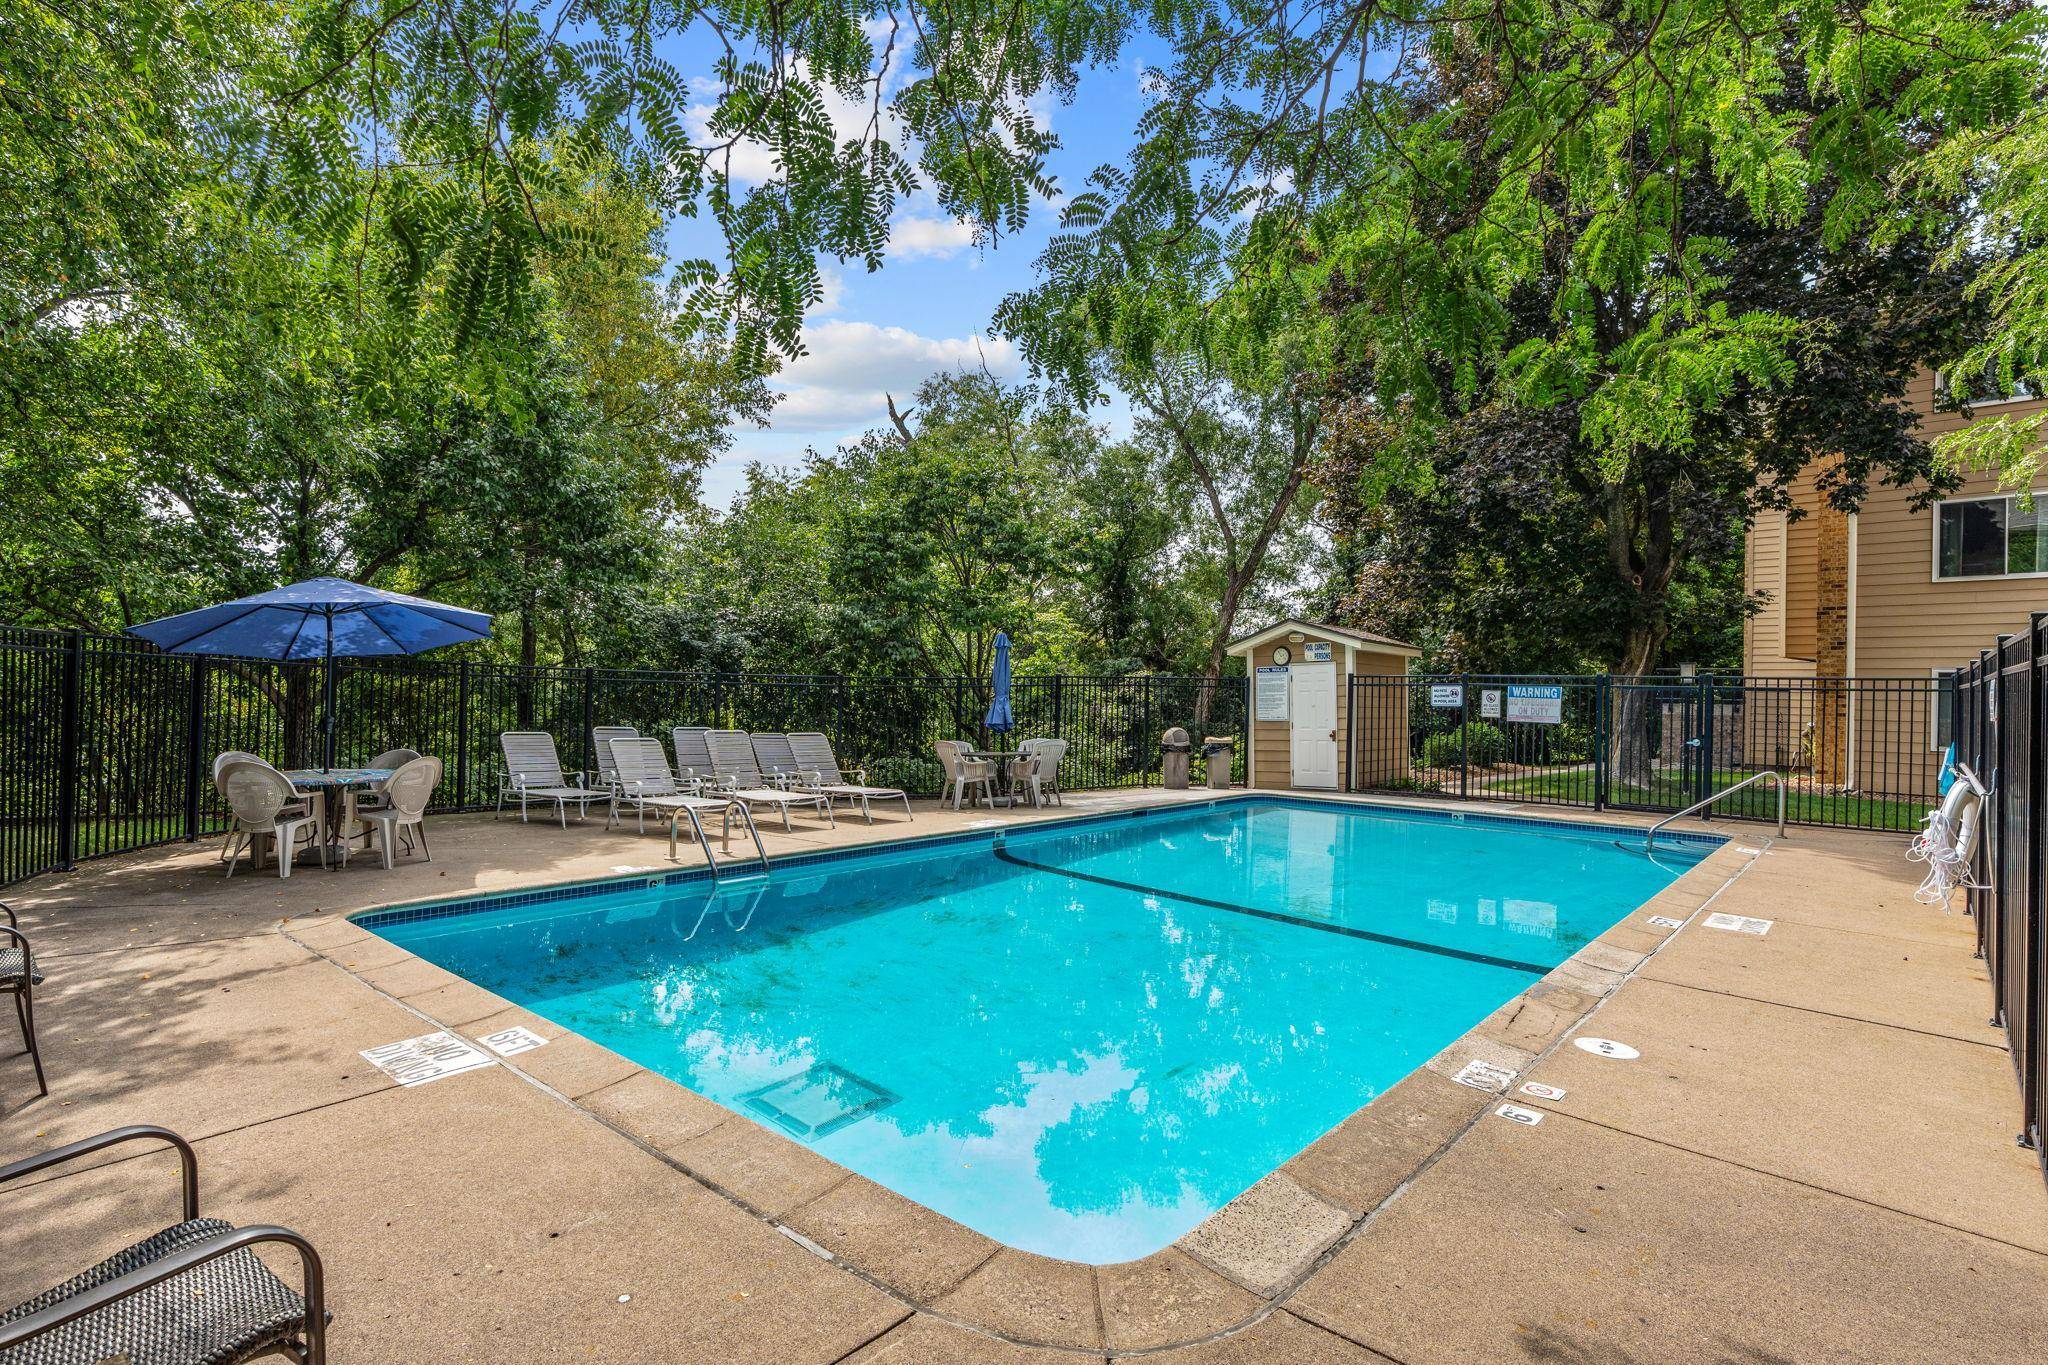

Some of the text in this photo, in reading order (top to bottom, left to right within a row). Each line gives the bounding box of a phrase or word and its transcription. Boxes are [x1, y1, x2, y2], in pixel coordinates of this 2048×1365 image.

[1512, 687, 1558, 698] WARNING
[1519, 707, 1549, 716] ON DUTY
